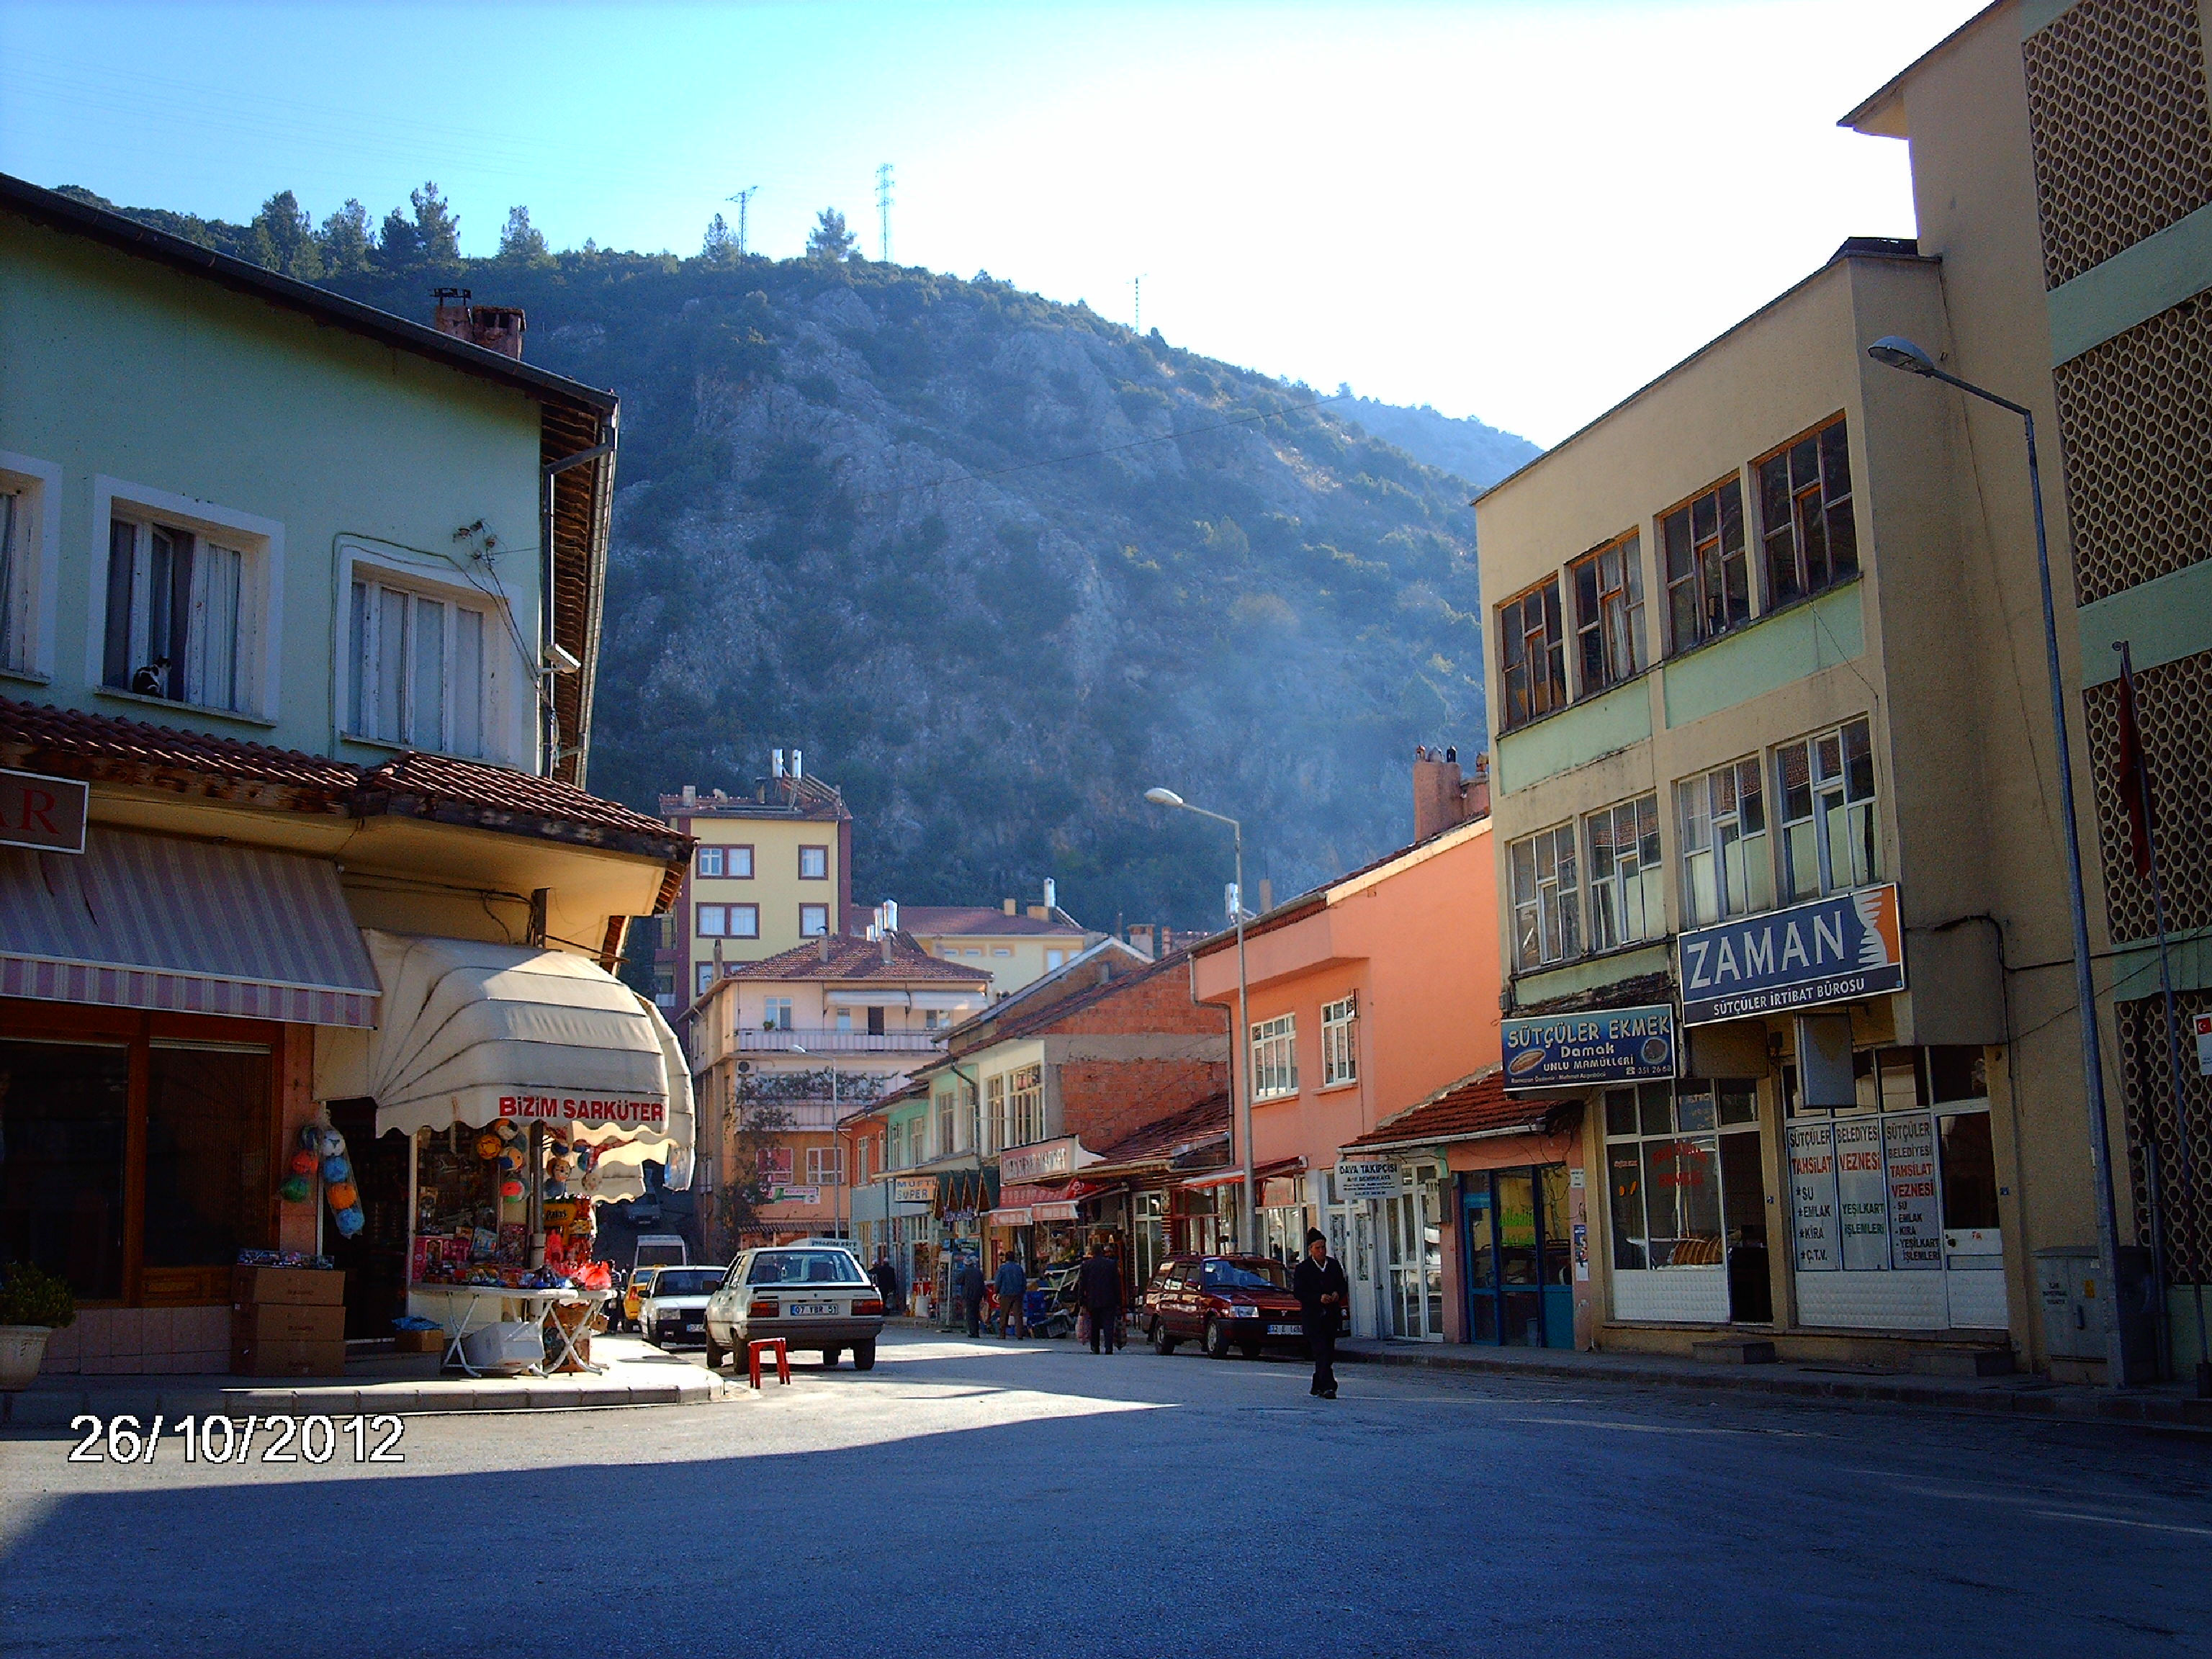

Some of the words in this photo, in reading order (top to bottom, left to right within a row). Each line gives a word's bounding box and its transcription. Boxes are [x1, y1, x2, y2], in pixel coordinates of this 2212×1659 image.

[1687, 911, 1845, 989] ZAMAN
[1714, 996, 1766, 1016] SÜTÇÜLER
[1770, 987, 1813, 1006] İRTİBAT
[1817, 978, 1865, 997] BÜROSU
[1508, 1022, 1600, 1048] SÜTÇÜLER
[1609, 1015, 1670, 1039] EKMEK
[1560, 1043, 1615, 1058] Damak
[1543, 1061, 1570, 1071] UNLU
[1573, 1054, 1635, 1070] MAMÜLLERİ
[499, 1096, 557, 1118] BİZİM
[1887, 1121, 1930, 1143] SÜTÇÜLER
[1791, 1155, 1832, 1175] TAHSİLAT
[1839, 1152, 1881, 1172] VEZNESİ
[1890, 1161, 1932, 1178] TAHSİLAT
[1892, 1179, 1934, 1199] VEZNESİ
[1803, 1205, 1831, 1218] EMLAK
